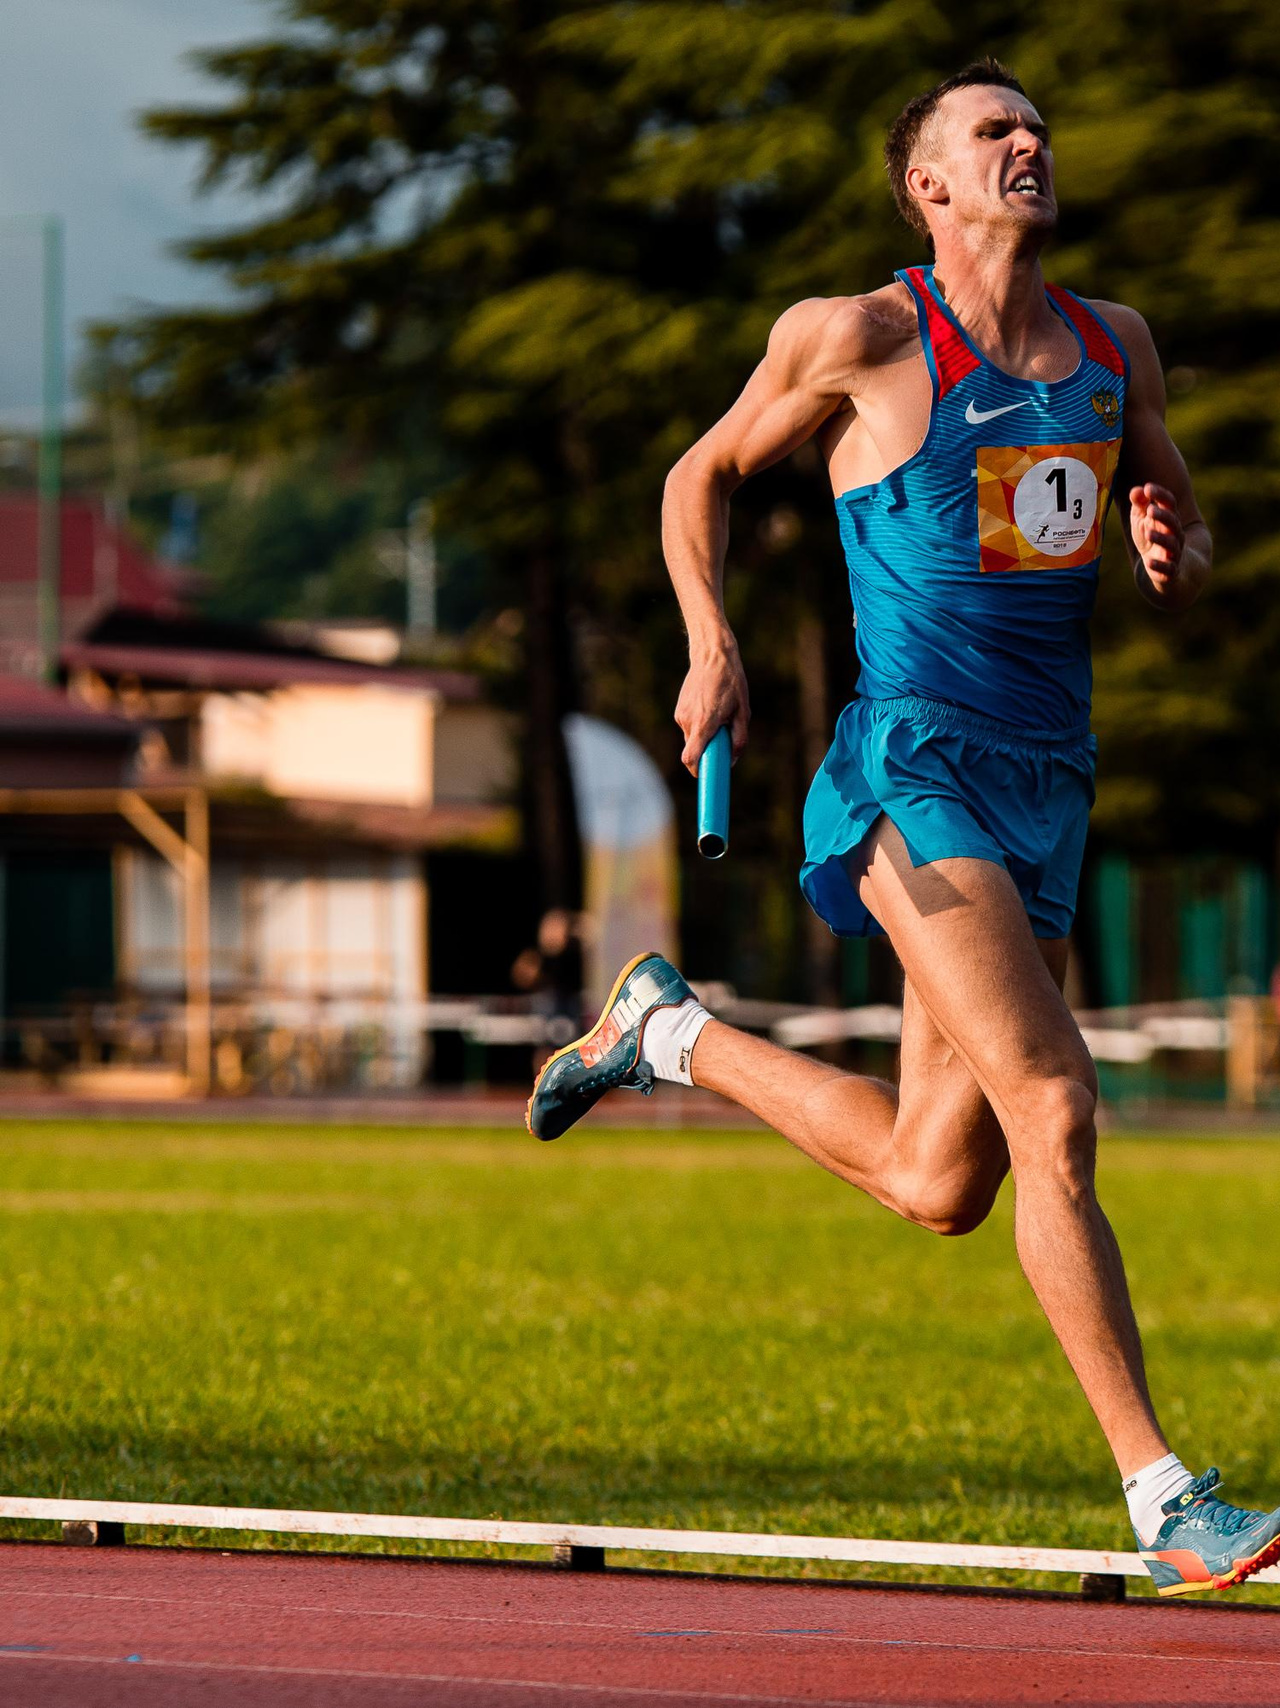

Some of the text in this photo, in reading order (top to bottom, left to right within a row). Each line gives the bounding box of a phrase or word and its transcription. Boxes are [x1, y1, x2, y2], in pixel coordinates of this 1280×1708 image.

[1045, 468, 1083, 519] 1 3
[679, 1046, 691, 1072] Lee
